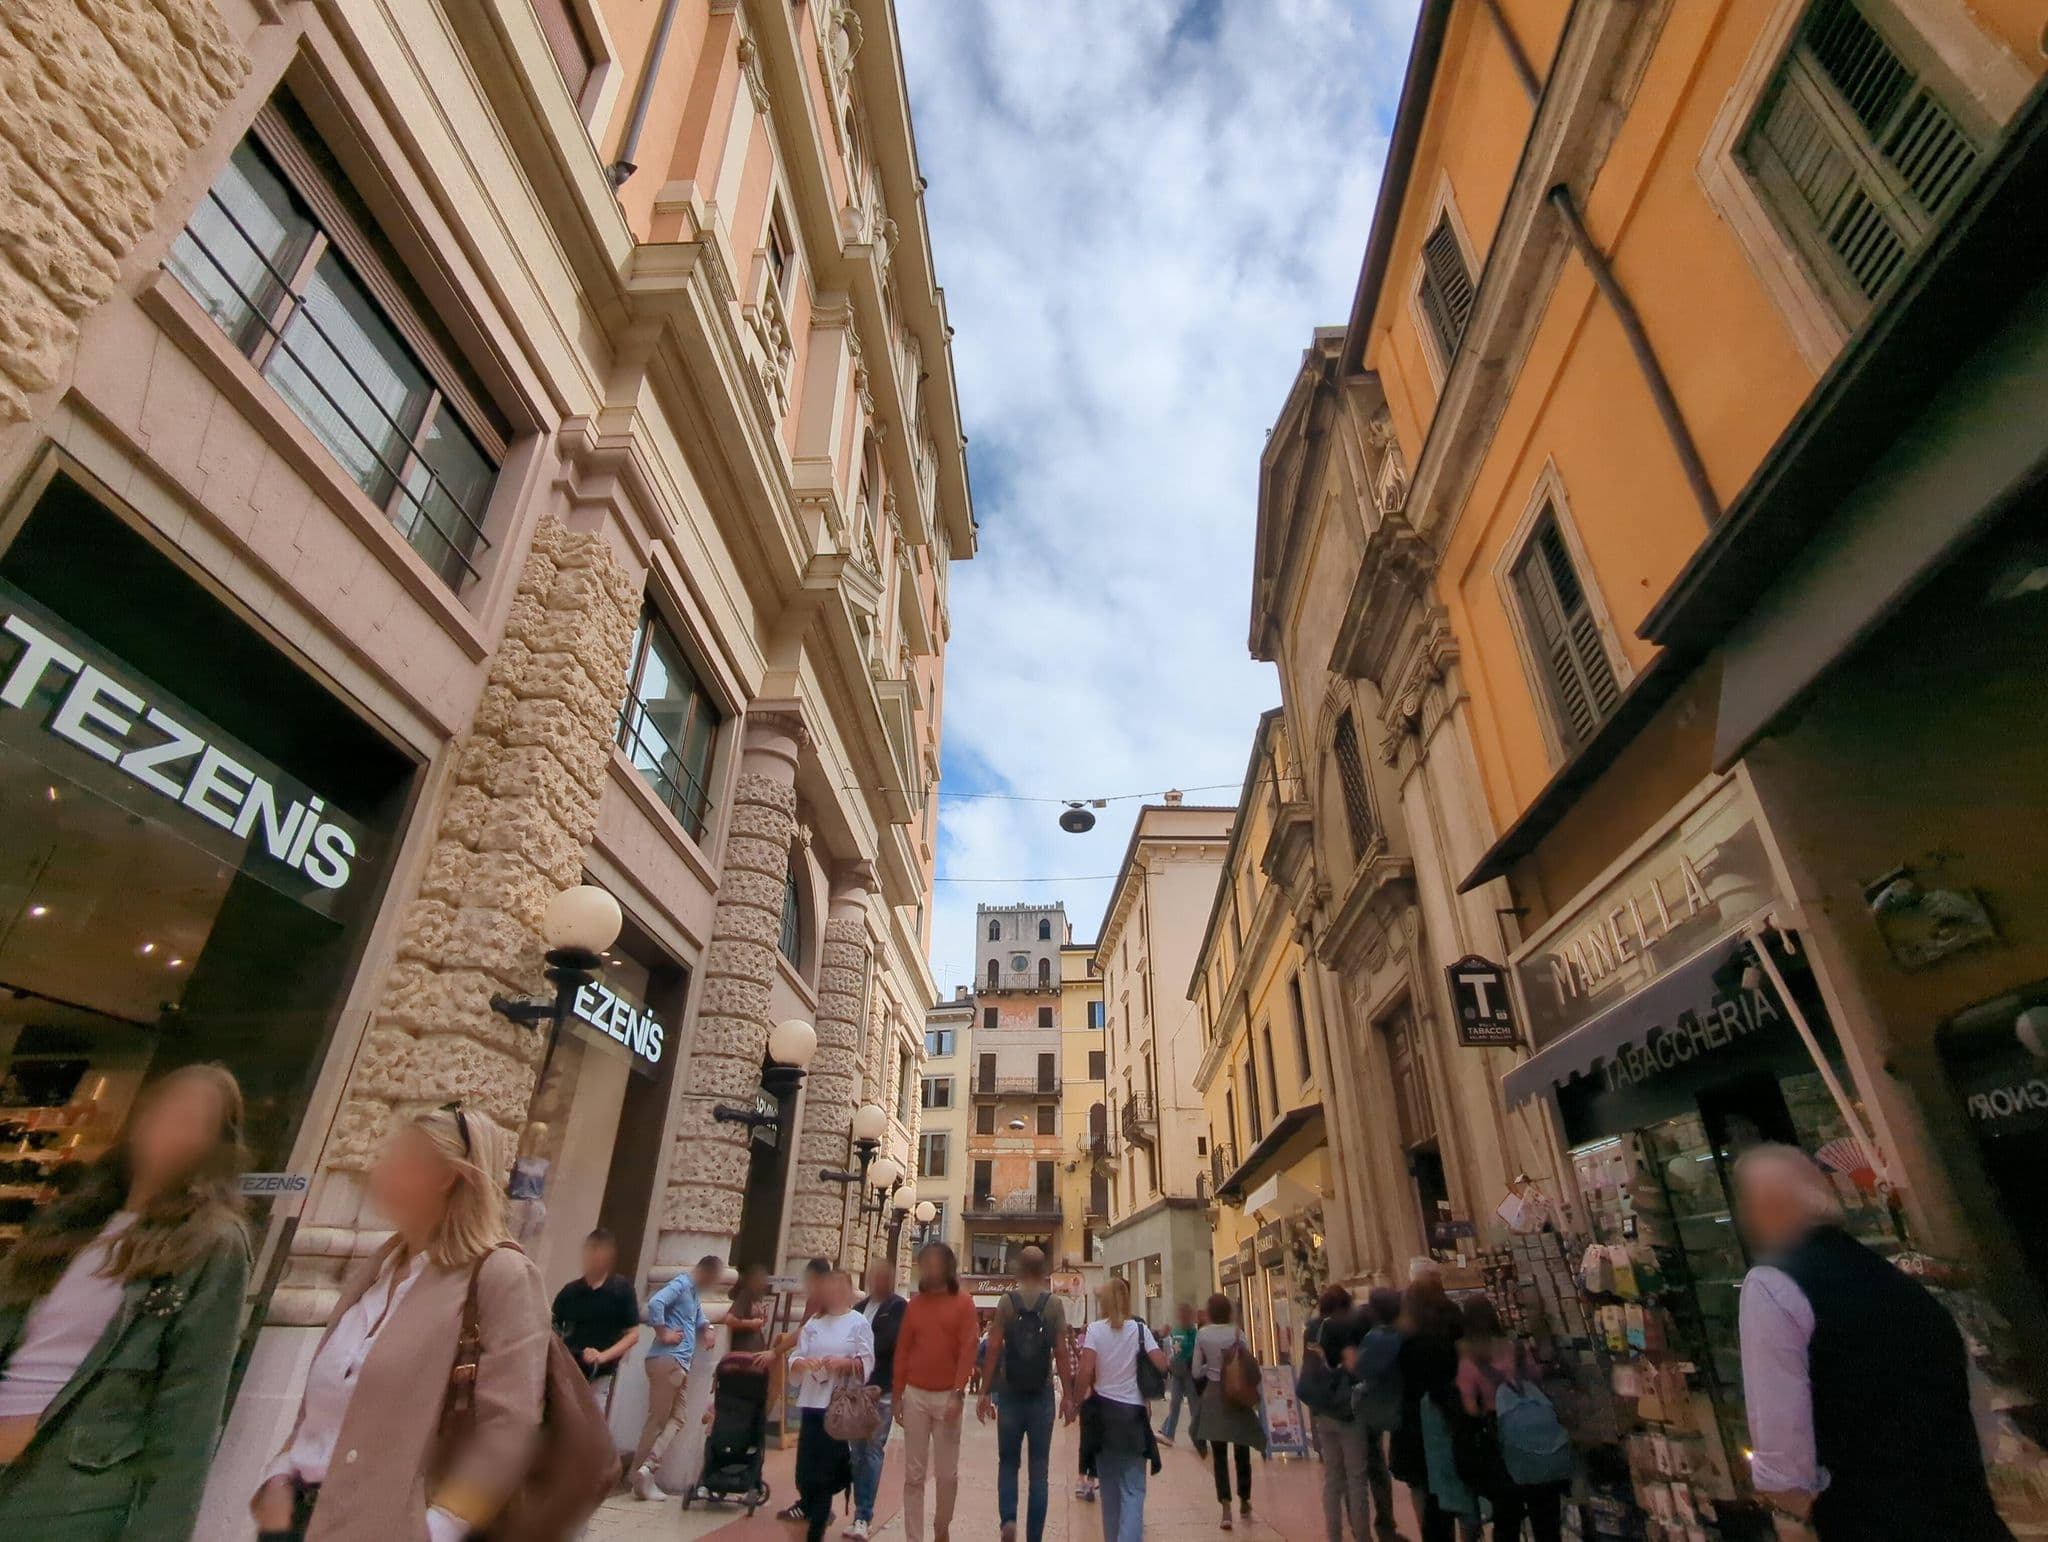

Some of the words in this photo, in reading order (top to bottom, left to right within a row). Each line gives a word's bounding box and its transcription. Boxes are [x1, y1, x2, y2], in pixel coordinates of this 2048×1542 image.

[1550, 854, 1714, 1006] MANELLA
[573, 980, 664, 1064] EZENIS
[1458, 973, 1497, 1018] T
[1467, 1026, 1512, 1035] TABACCHI
[1603, 987, 1779, 1093] TABACCHERIA
[241, 1173, 307, 1191] EZENIS
